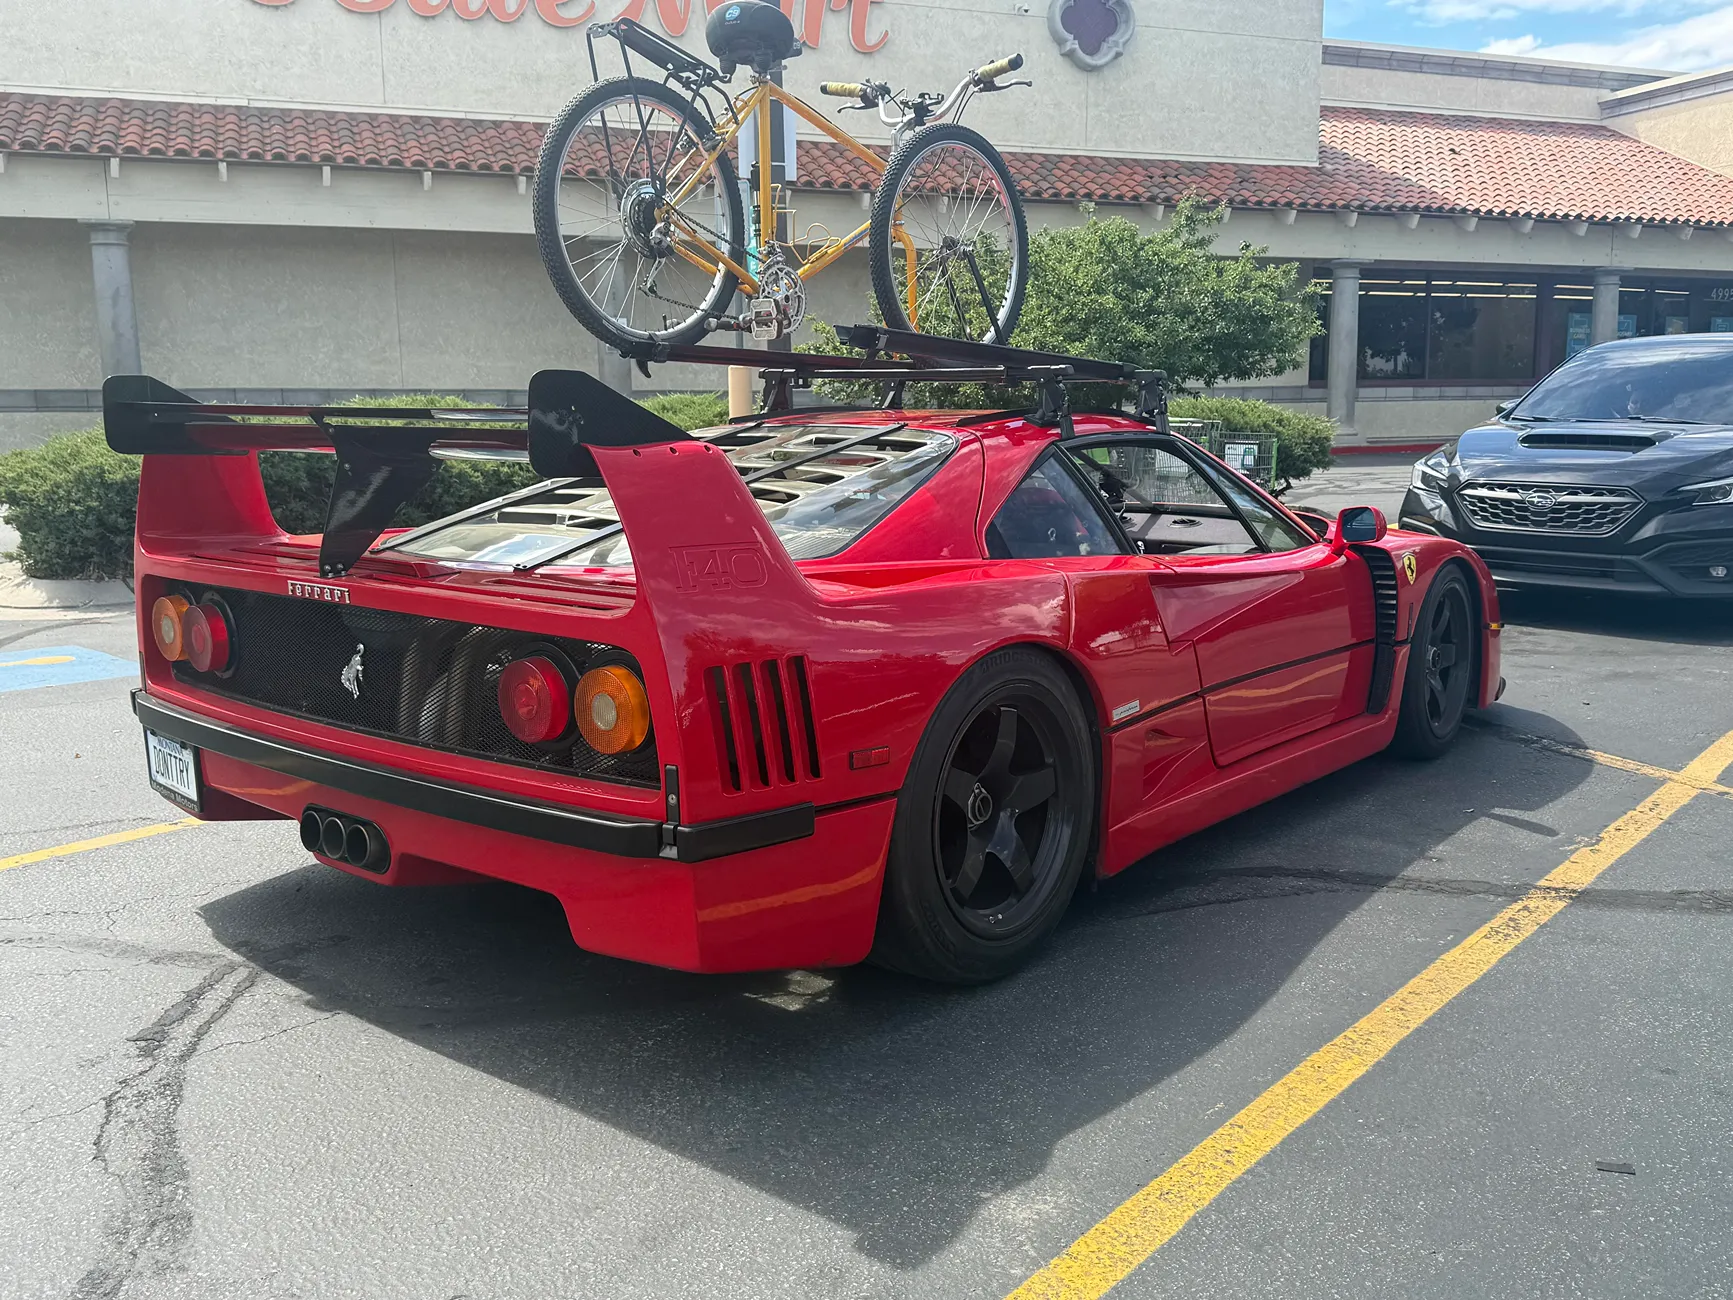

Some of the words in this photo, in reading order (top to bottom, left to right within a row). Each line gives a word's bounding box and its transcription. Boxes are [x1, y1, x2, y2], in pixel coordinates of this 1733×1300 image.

[726, 9, 740, 18] C9
[668, 541, 768, 594] F40
[287, 580, 350, 604] Ferrari
[153, 745, 190, 790] DONTTRY
